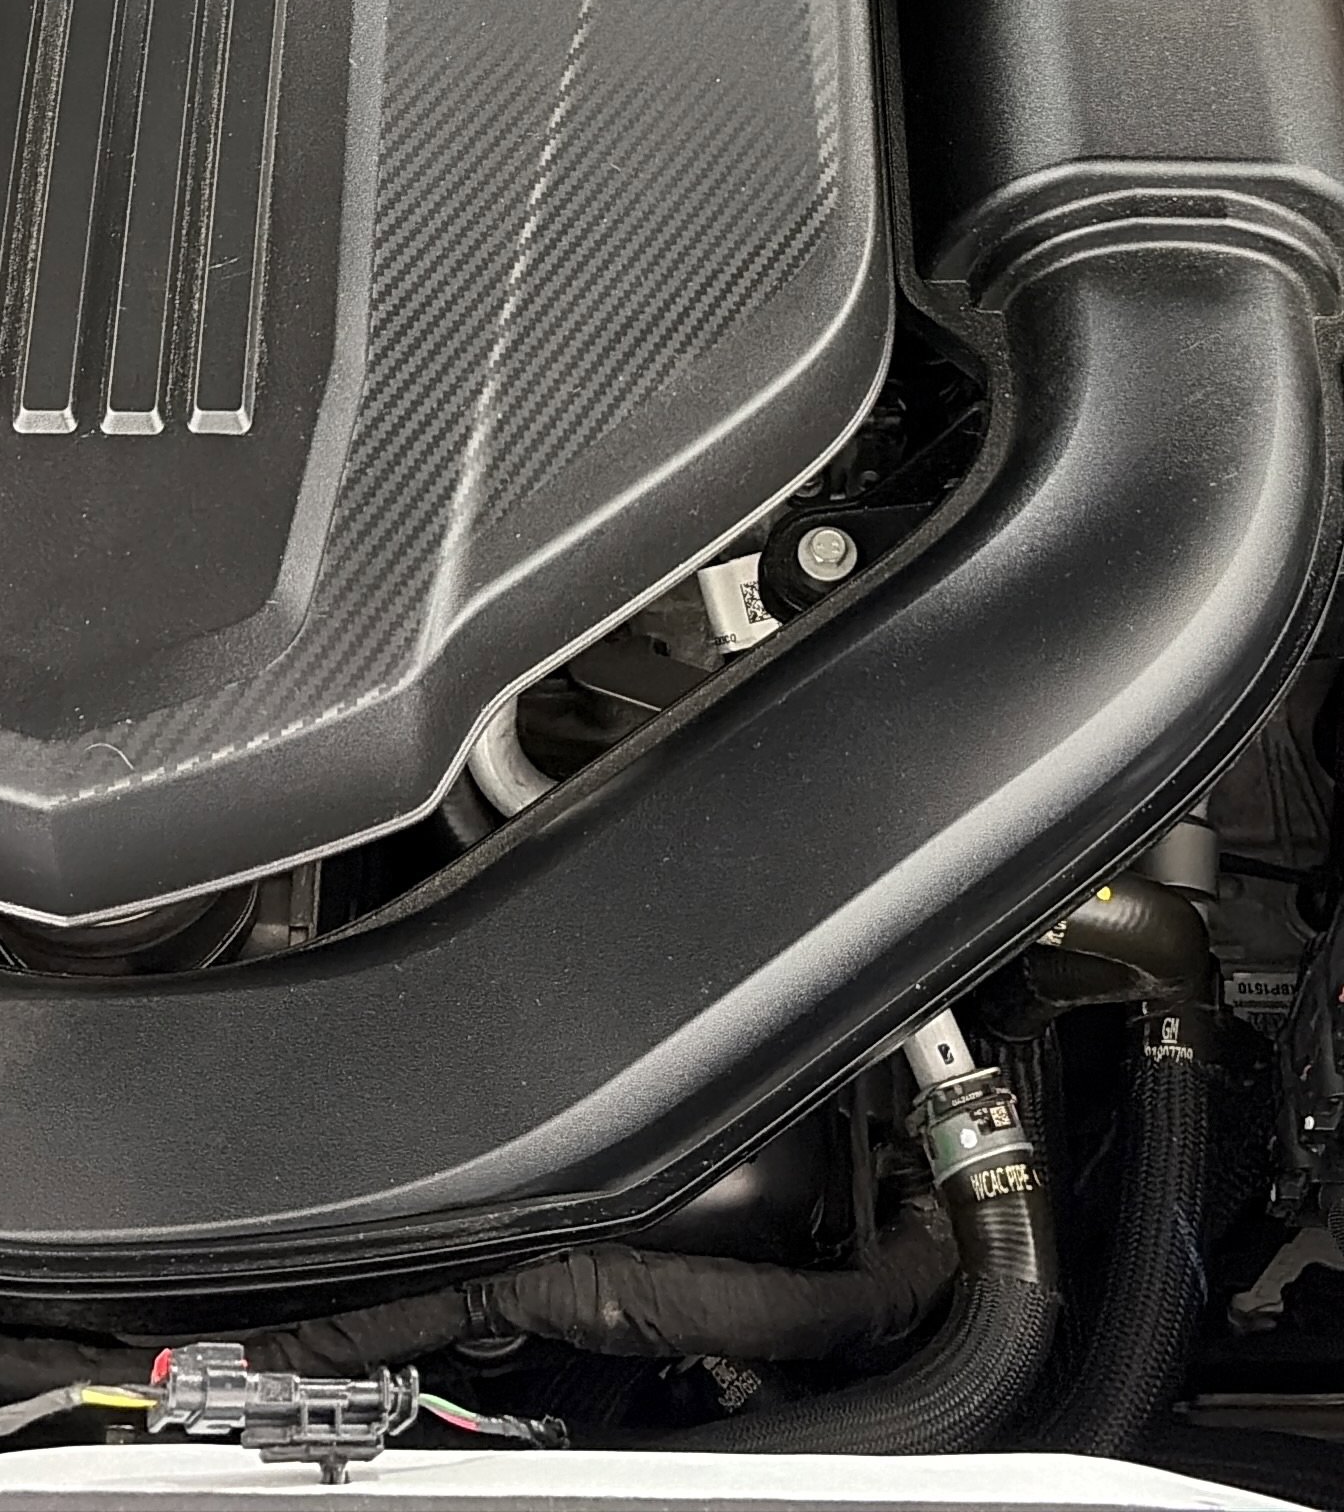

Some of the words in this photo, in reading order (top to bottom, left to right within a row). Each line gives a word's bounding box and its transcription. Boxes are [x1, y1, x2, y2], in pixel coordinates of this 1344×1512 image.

[1161, 1017, 1181, 1043] GM
[970, 1167, 1009, 1202] WCAC
[1005, 1163, 1034, 1192] PIPE
